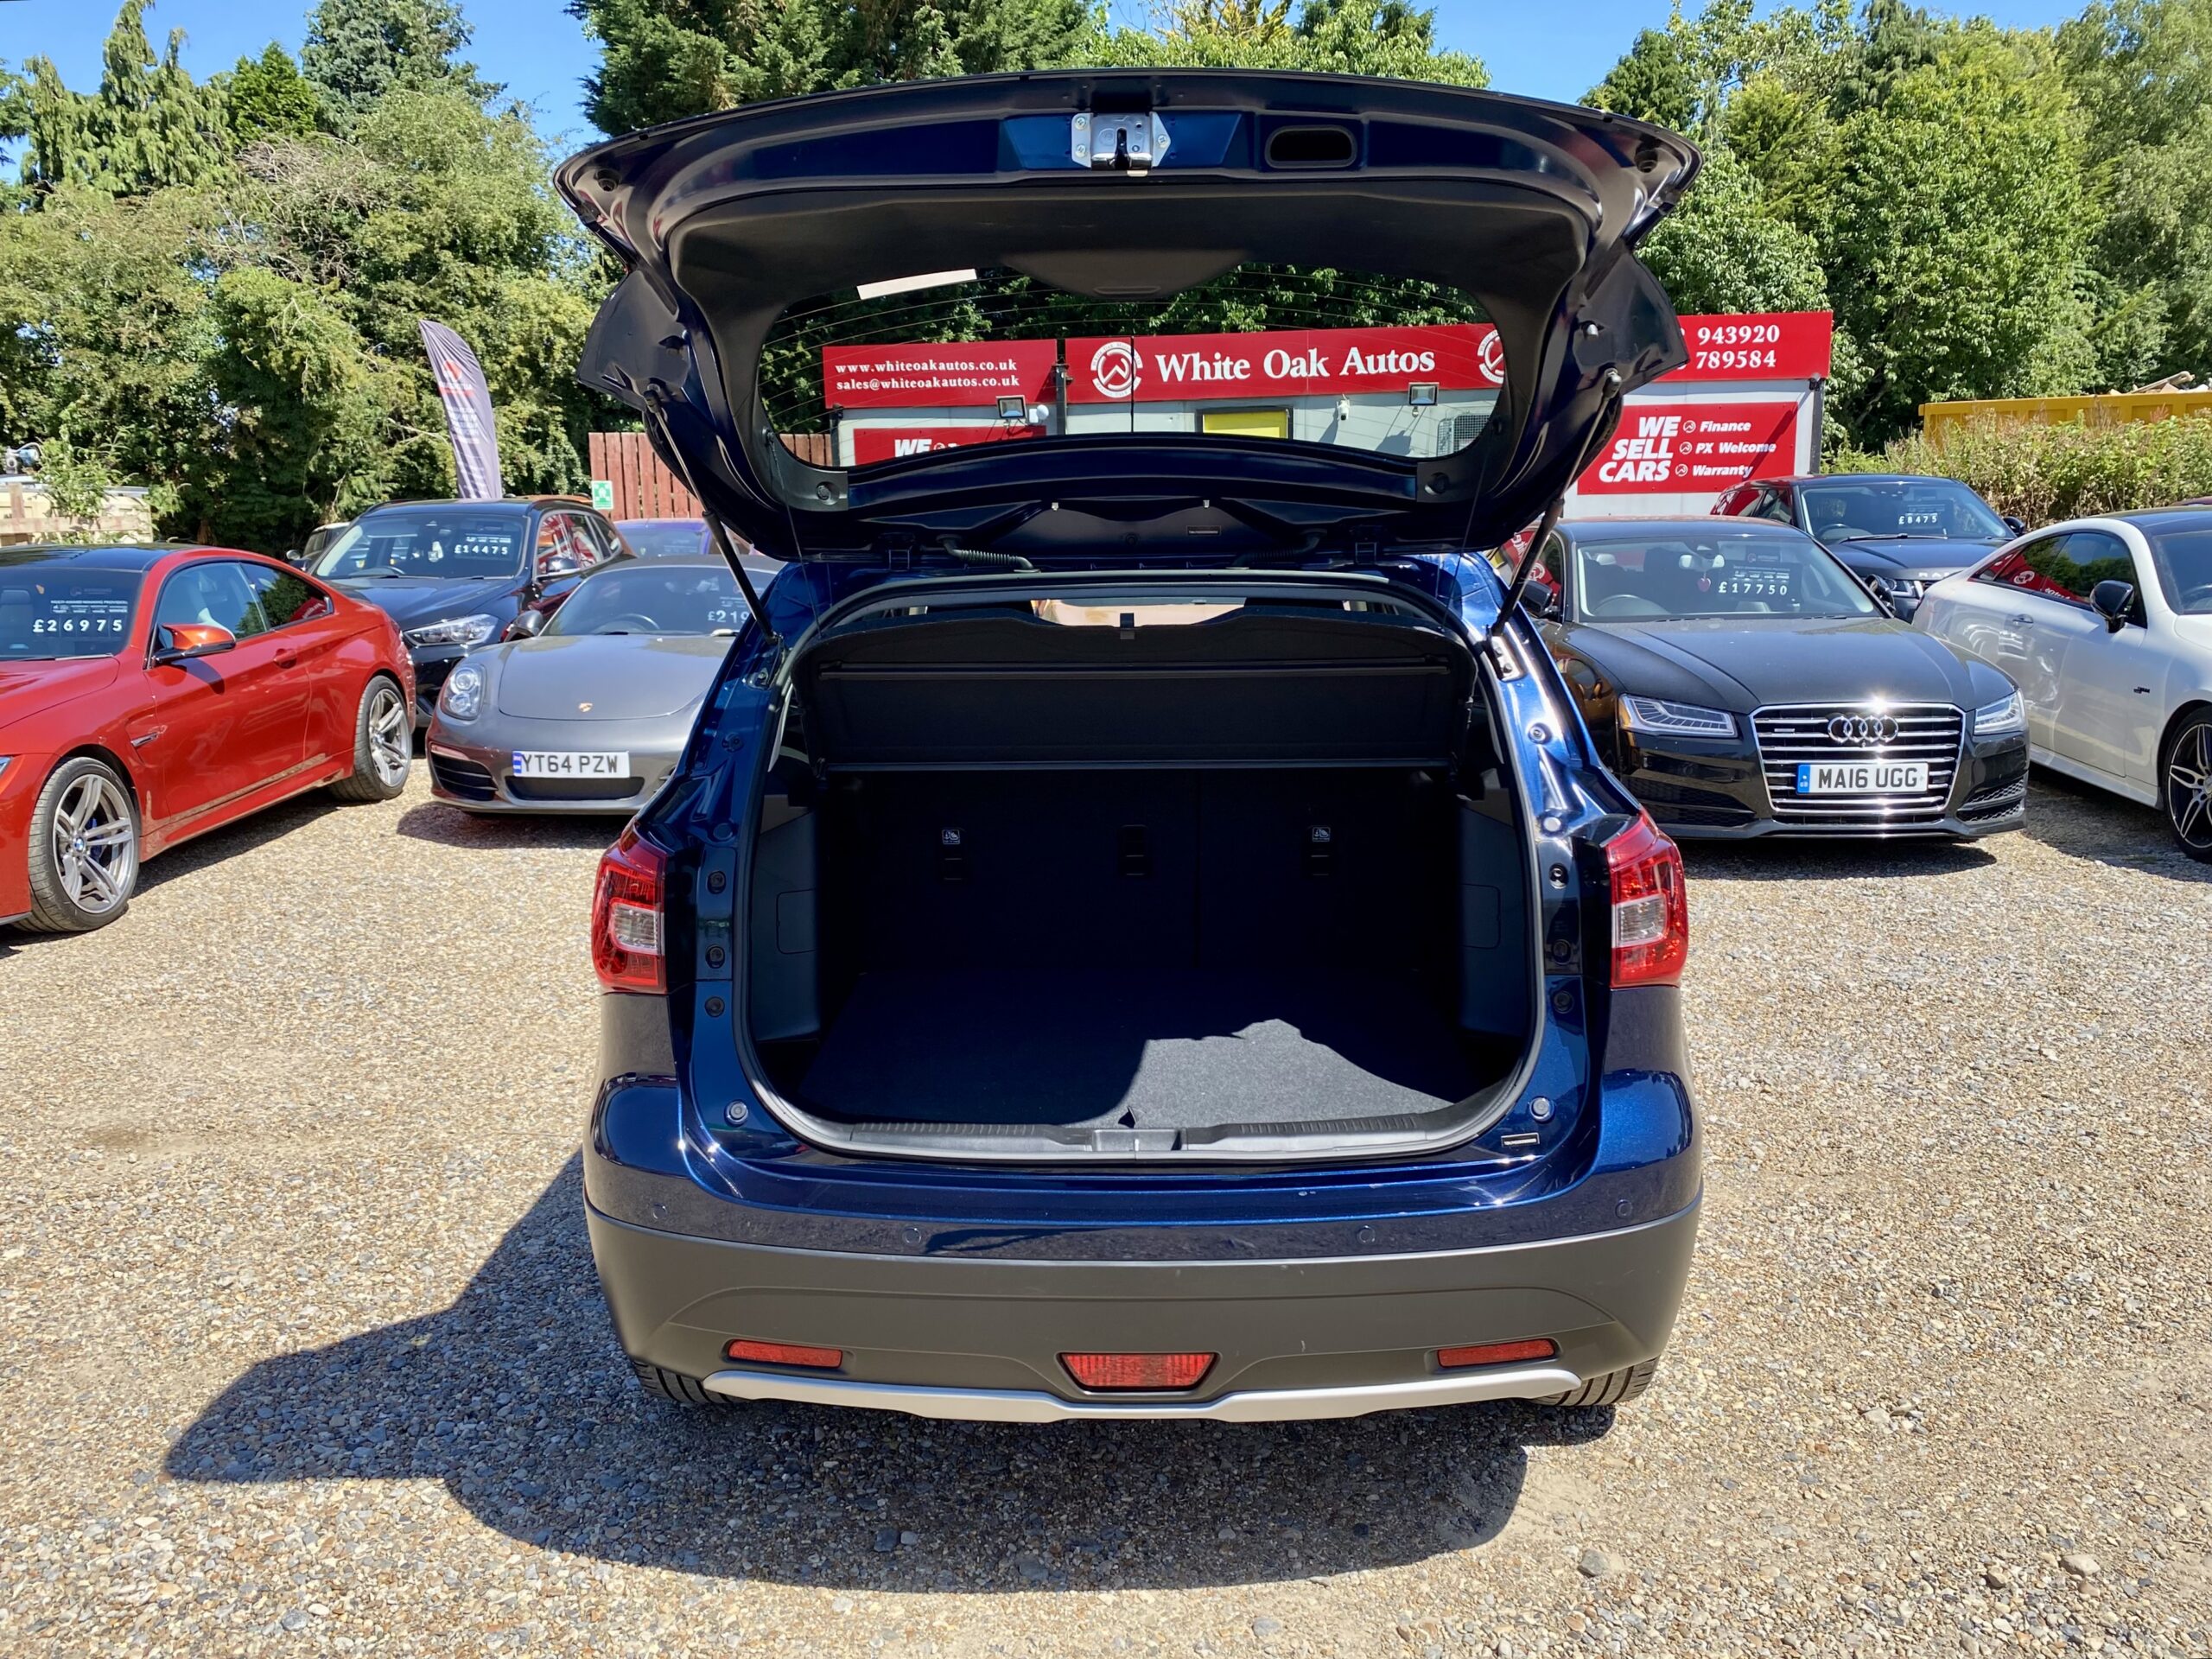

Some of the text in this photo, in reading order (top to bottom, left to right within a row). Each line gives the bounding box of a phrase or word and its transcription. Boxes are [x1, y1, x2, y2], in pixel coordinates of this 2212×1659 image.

[1697, 325, 1780, 345] 943920
[835, 359, 1017, 373] www.whiteoakautos.co.uk
[1154, 352, 1251, 382] White
[1263, 348, 1331, 378] Oak
[1339, 346, 1436, 375] Autos
[1696, 350, 1777, 369] 789584
[836, 375, 1020, 391] sales@whiteoakautos.co.uk
[1638, 416, 1681, 437] WE
[1700, 421, 1751, 432] Finance
[1611, 438, 1674, 460] SELL
[1695, 442, 1777, 454] PX Welcome
[1599, 460, 1672, 482] CARS
[1692, 465, 1754, 479] Warranty
[454, 544, 509, 555] £14475
[1718, 582, 1788, 595] £17750
[707, 609, 749, 623] £219
[32, 619, 123, 632] £26975
[521, 754, 618, 773] YT64 PZW
[1818, 767, 1917, 789] MA16 UGG
